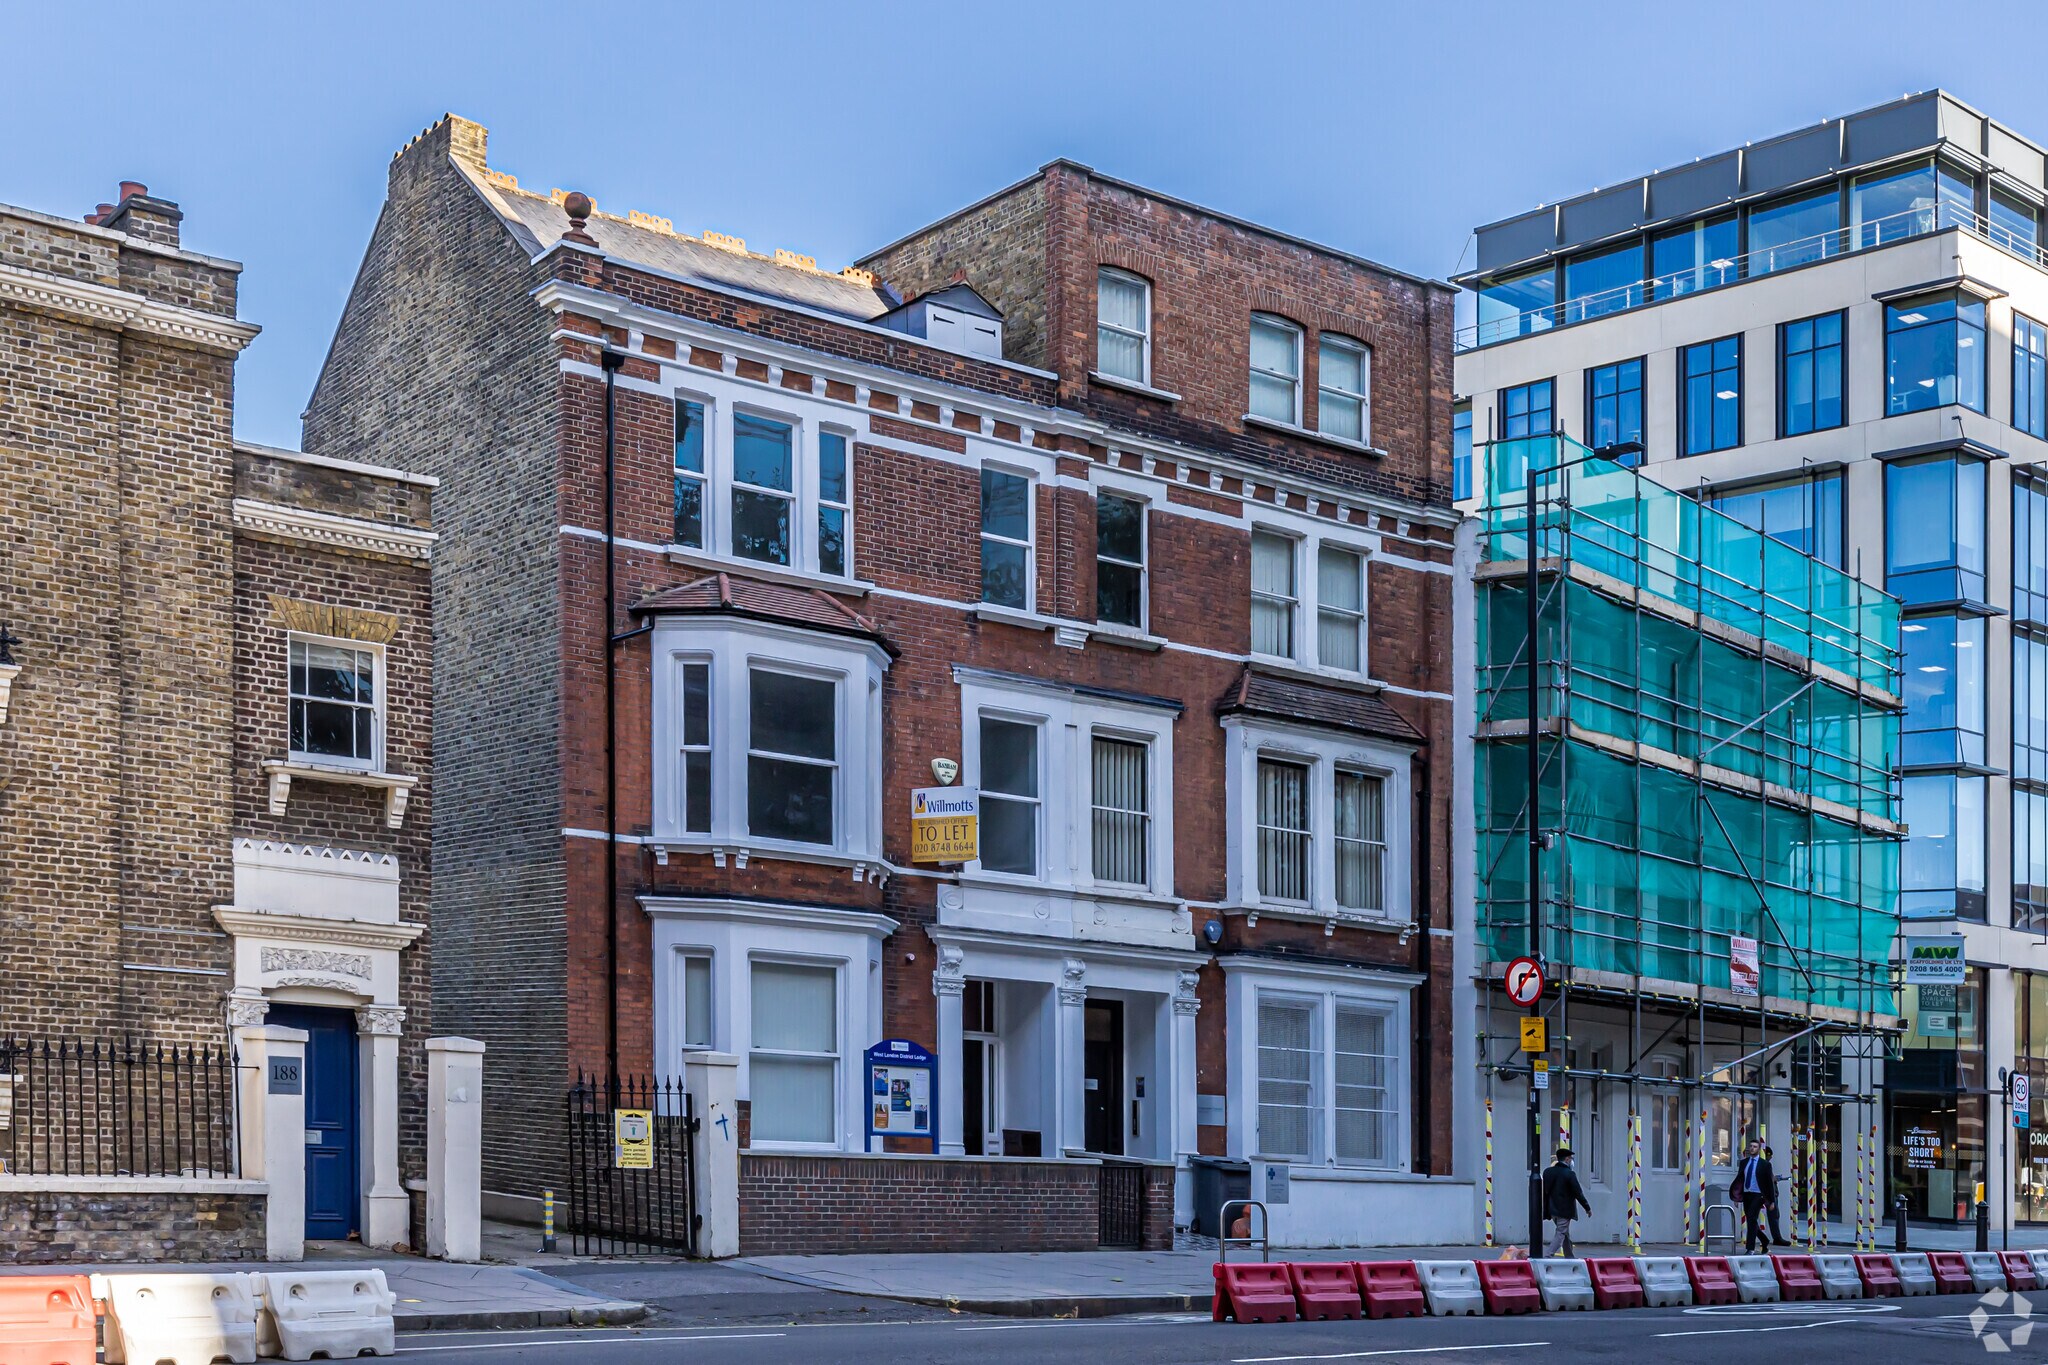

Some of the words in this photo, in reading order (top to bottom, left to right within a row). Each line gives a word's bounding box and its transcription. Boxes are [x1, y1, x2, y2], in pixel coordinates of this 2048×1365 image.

[926, 800, 974, 812] Willmotts
[919, 826, 937, 841] TO
[944, 824, 968, 840] LET
[914, 844, 928, 852] 020
[930, 843, 950, 852] 8748
[954, 842, 974, 851] 6644
[273, 1065, 297, 1080] 188
[2016, 1083, 2026, 1094] 20
[2014, 1102, 2027, 1110] ZONE
[1903, 1136, 1925, 1146] LIFE'S
[1927, 1137, 1940, 1146] TOO
[1909, 1147, 1934, 1158] SHORT
